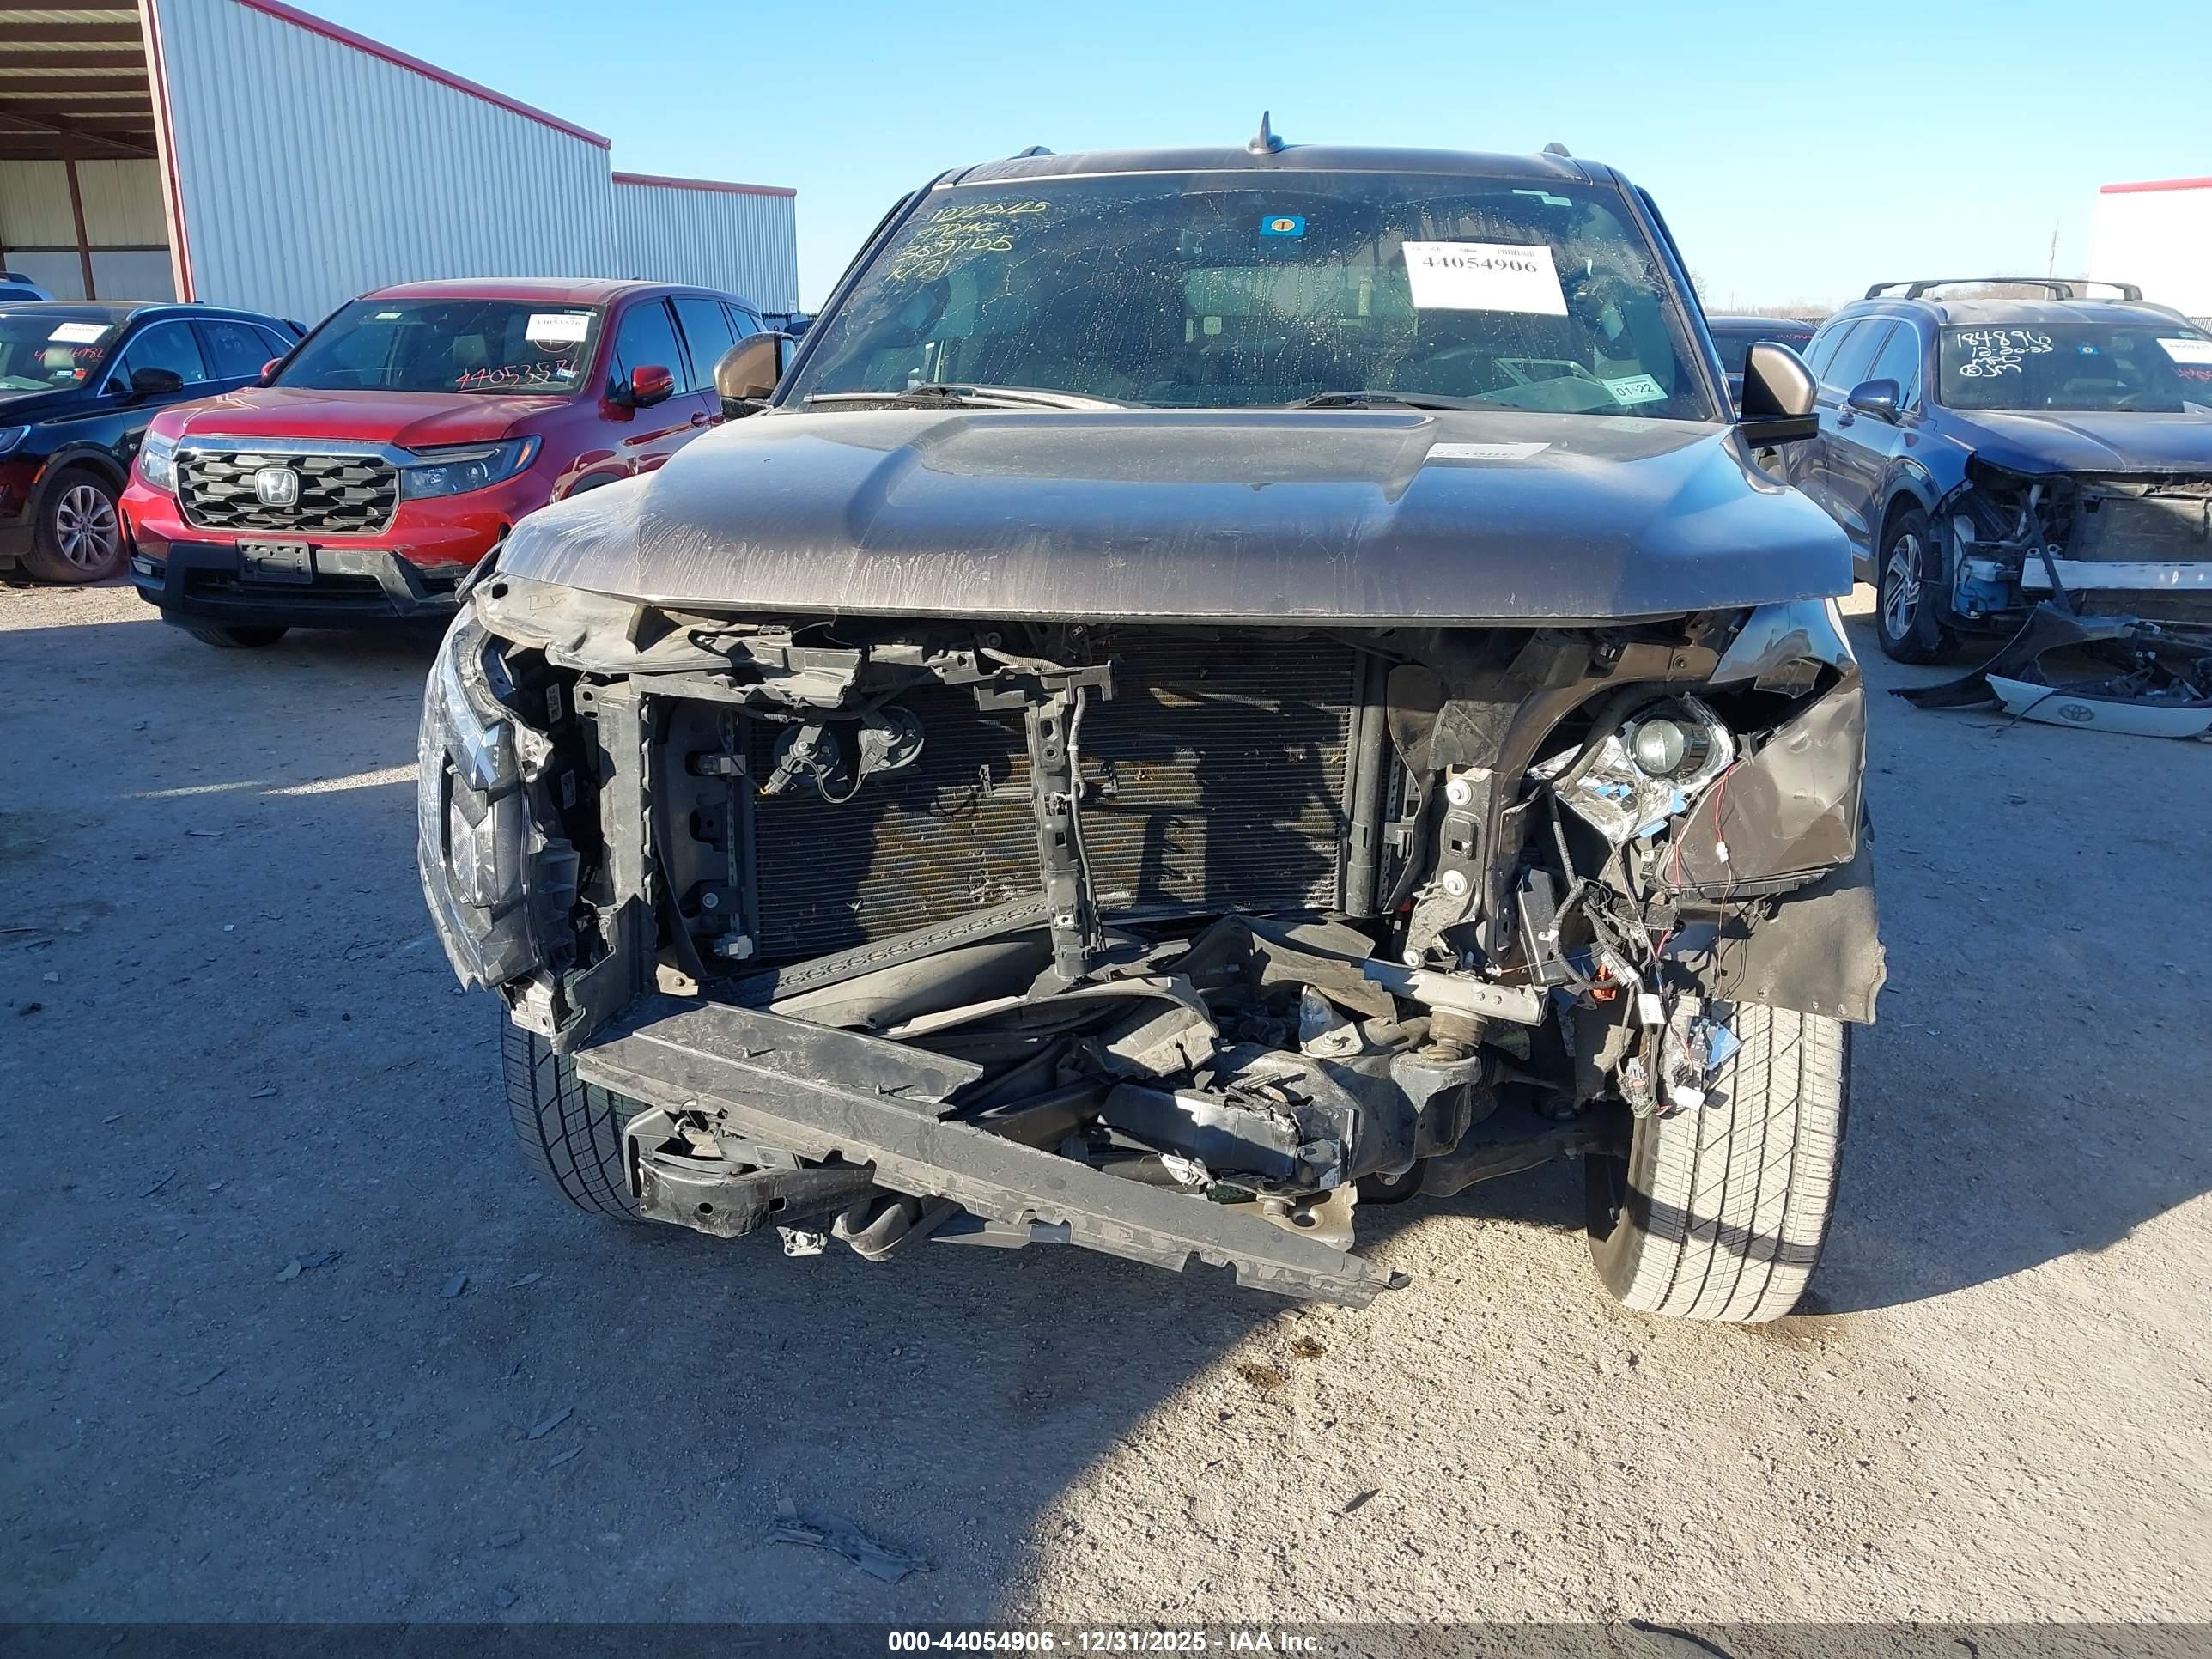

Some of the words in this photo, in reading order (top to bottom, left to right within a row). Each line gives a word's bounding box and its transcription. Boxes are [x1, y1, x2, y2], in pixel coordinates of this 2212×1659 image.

[930, 201, 1052, 223] 12/20/25
[1422, 256, 1538, 273] 44054906
[1957, 331, 2052, 349] 184896
[1637, 384, 1655, 393] 22
